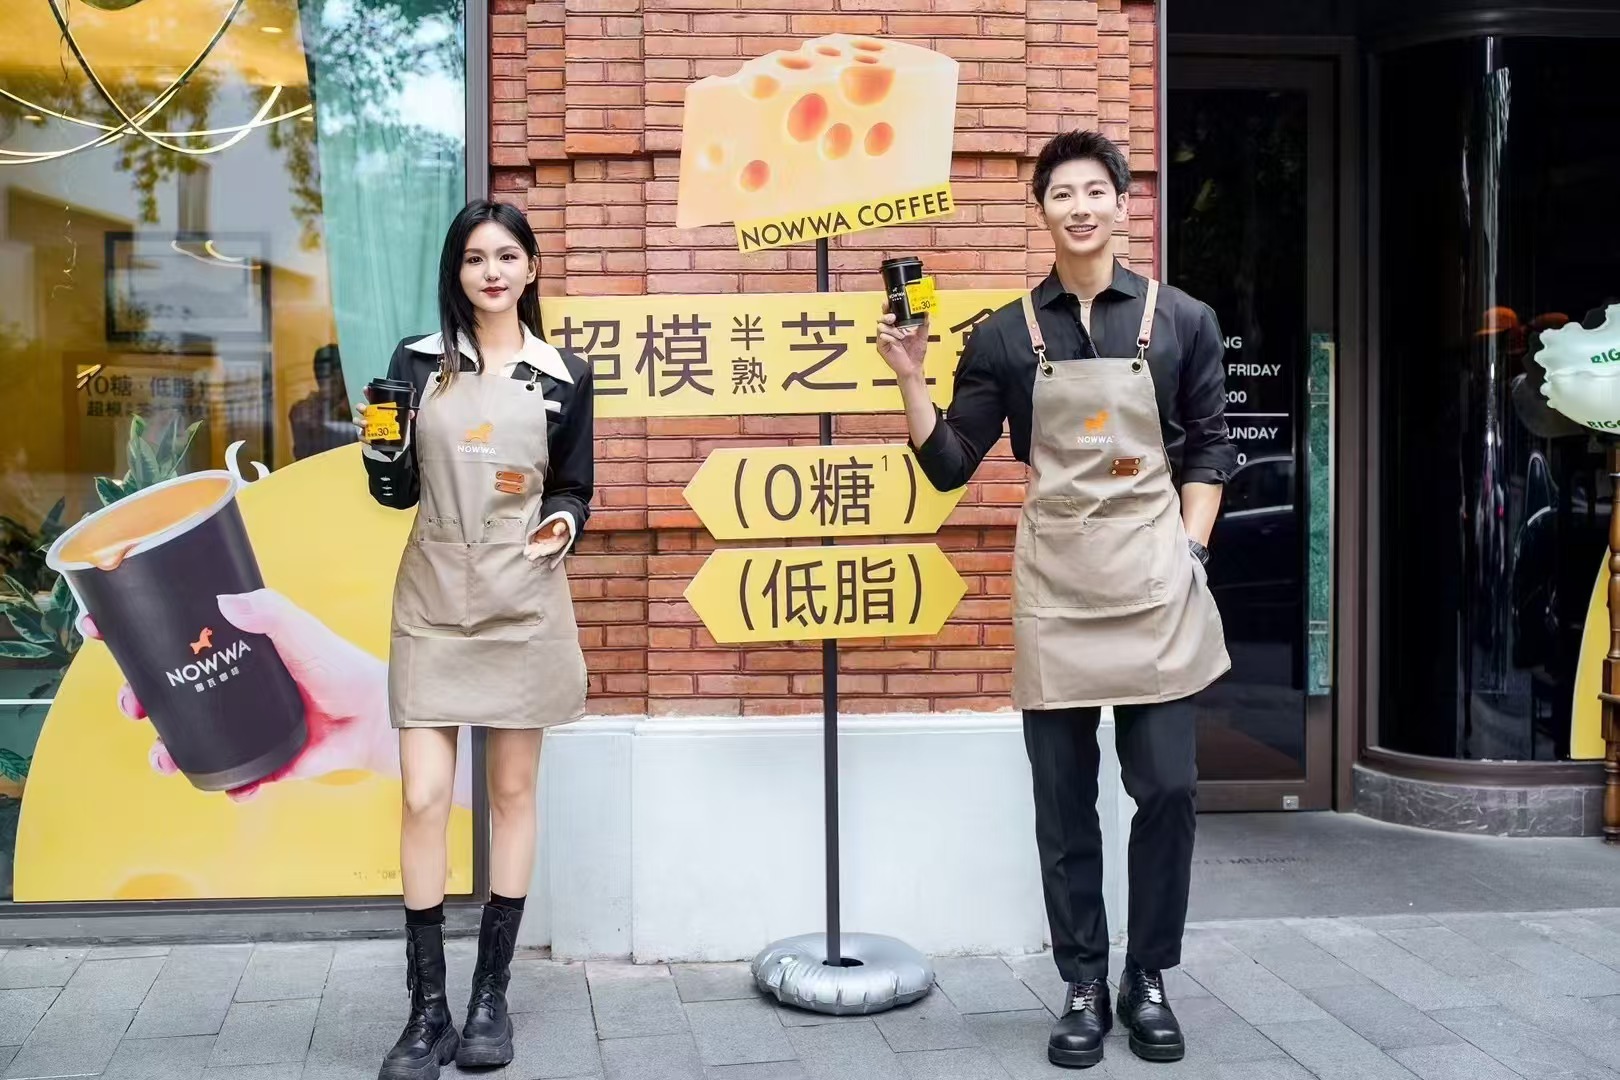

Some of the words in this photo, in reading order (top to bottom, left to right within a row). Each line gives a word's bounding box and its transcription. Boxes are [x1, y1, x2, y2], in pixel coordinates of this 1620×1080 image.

[741, 211, 852, 250] NOWWA
[857, 190, 950, 227] COFFEE
[1228, 364, 1281, 376] FRIDAY
[377, 427, 389, 437] 30
[1227, 427, 1278, 440] UNDAY
[1077, 435, 1113, 444] NOWWA
[457, 445, 497, 455] NOWWA
[739, 553, 922, 631] (低脂)
[165, 639, 252, 687] NOWWA
